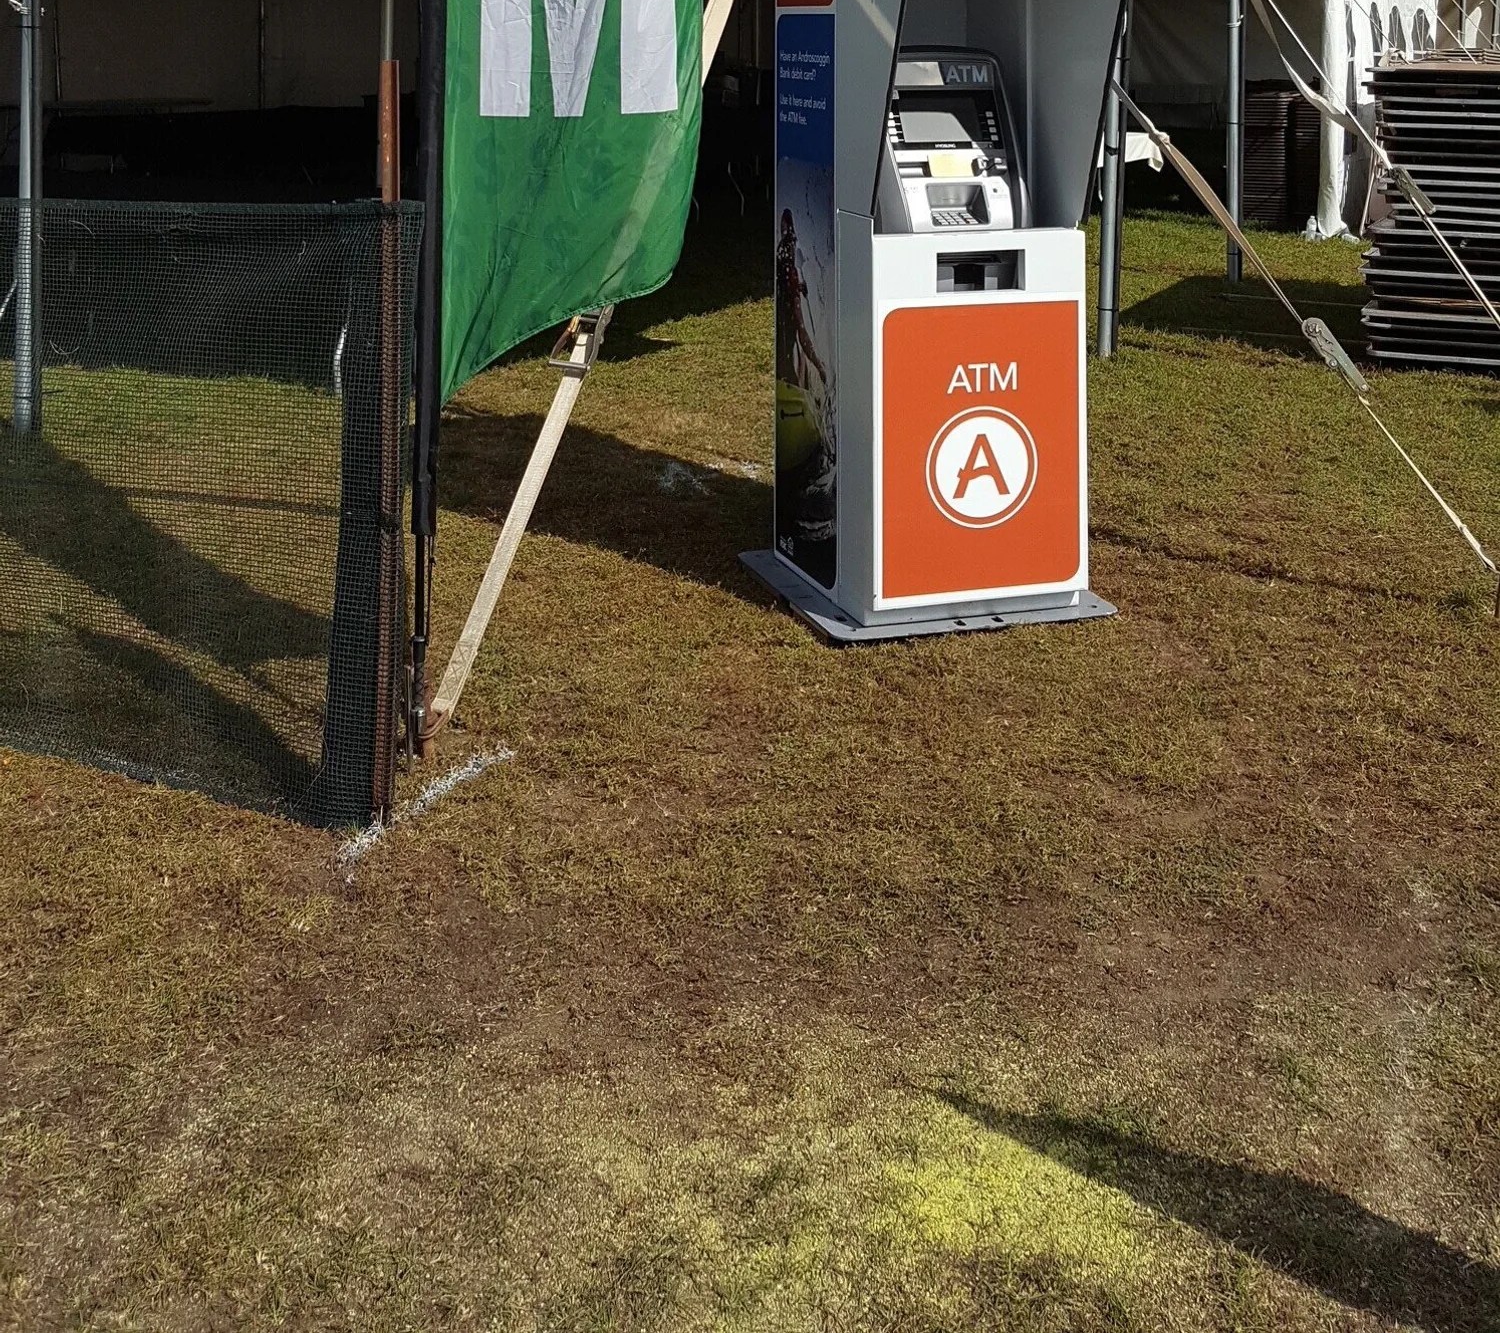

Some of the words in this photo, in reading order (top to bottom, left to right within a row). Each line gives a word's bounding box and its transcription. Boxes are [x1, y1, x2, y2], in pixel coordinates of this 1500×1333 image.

[780, 50, 791, 61] Have
[792, 53, 797, 62] an
[798, 51, 831, 67] Androscoggin
[780, 66, 790, 78] Bank
[791, 67, 803, 80] debit
[946, 65, 989, 84] ATM
[780, 93, 788, 105] Use
[793, 94, 803, 107] here
[803, 96, 812, 108] and
[813, 97, 826, 110] avoid
[788, 111, 798, 123] ATM
[947, 362, 1018, 394] ATM
